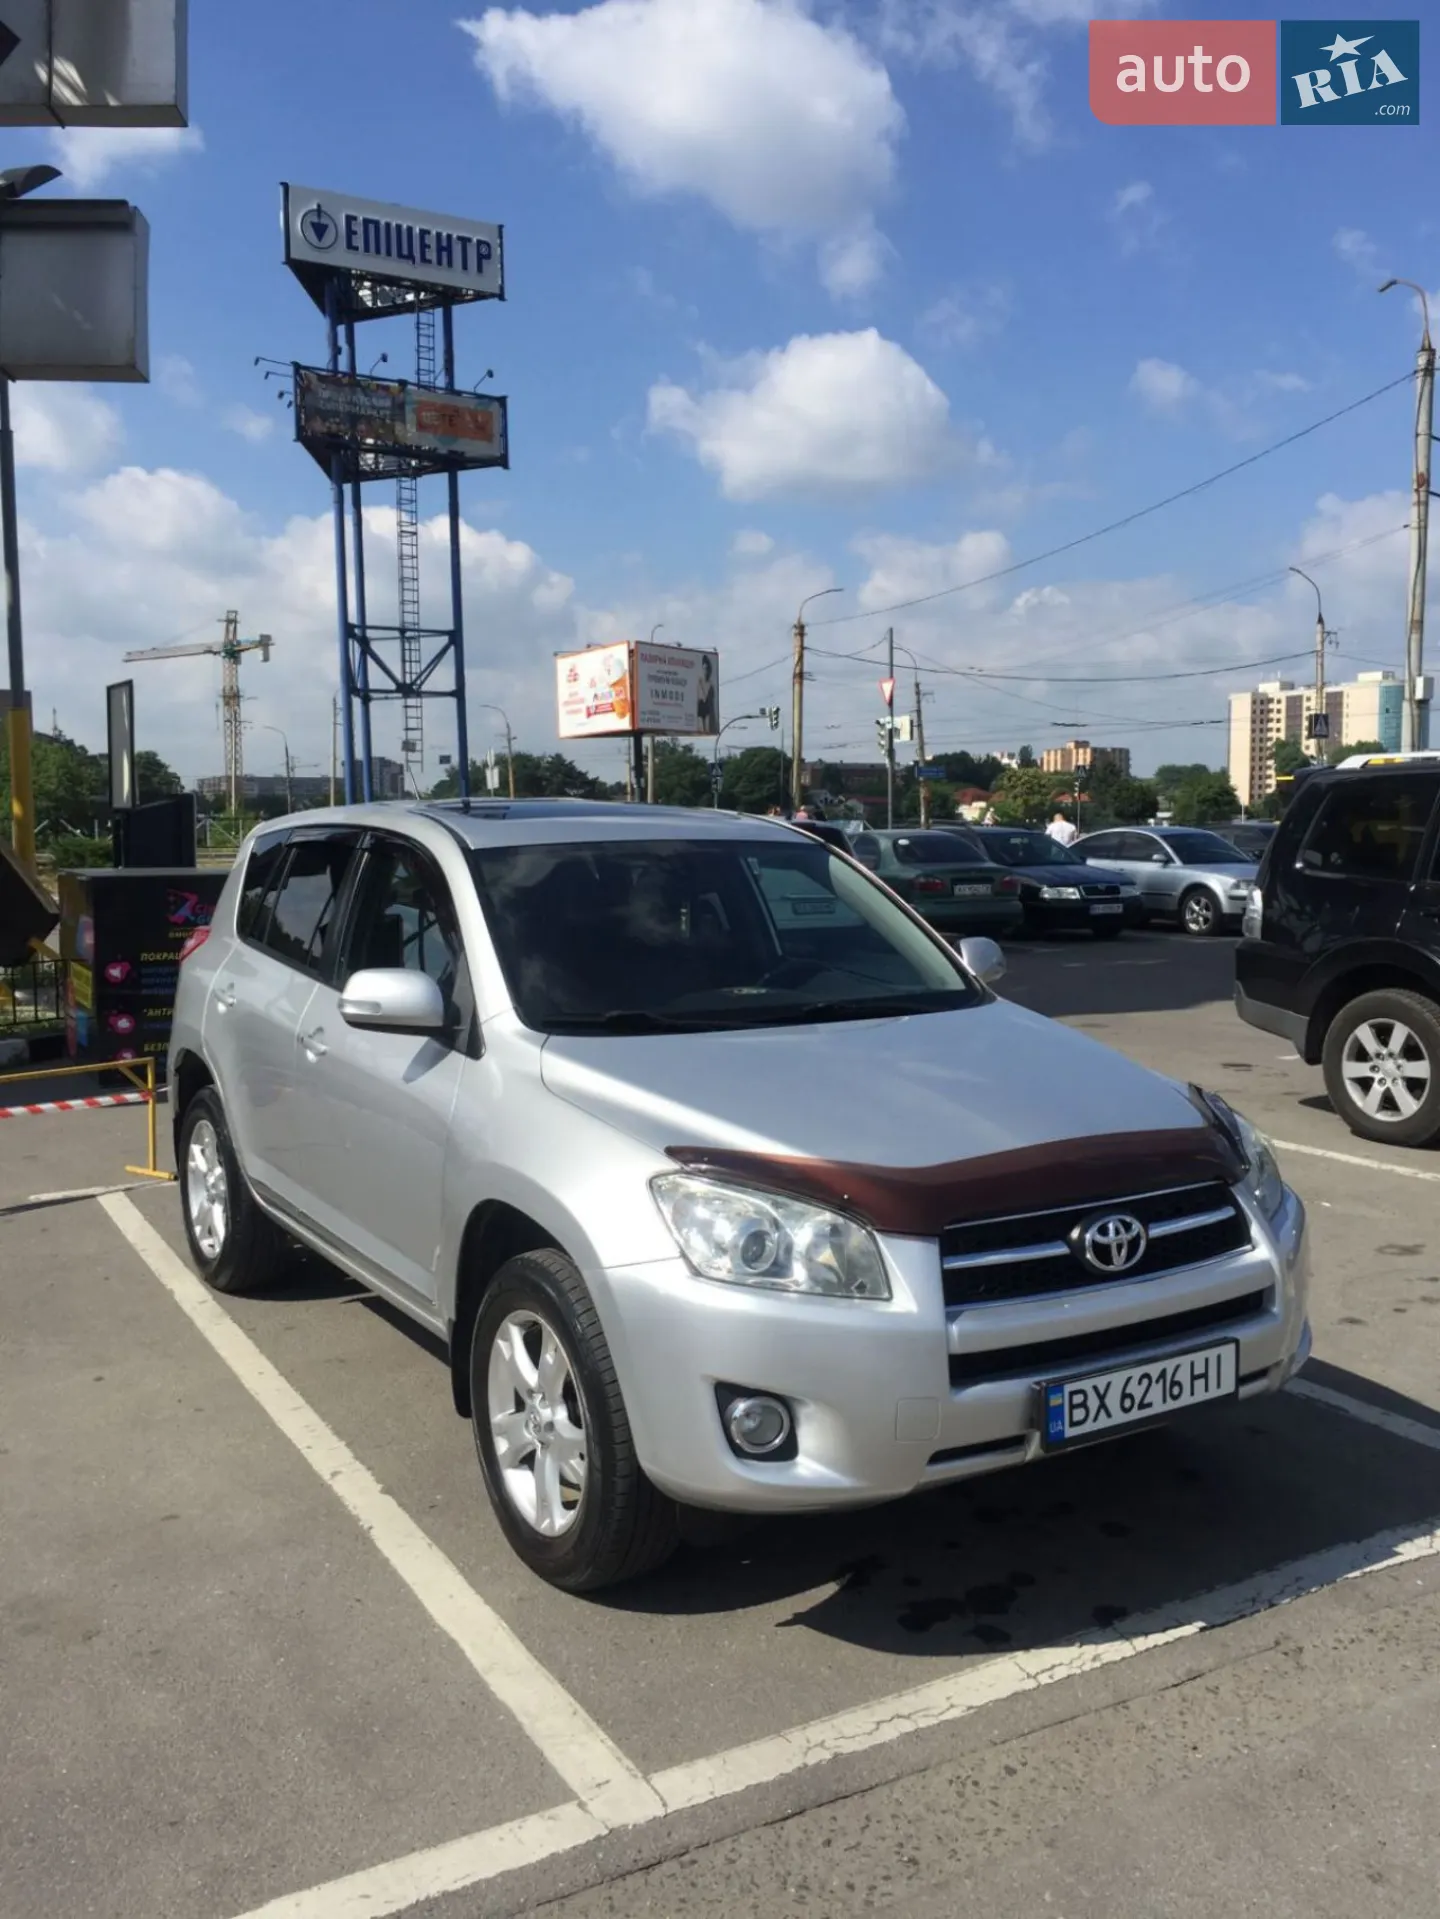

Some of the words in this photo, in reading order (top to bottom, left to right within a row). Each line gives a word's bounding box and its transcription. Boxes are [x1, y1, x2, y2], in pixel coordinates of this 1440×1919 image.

[344, 214, 492, 273] ЕПІЦЕНТР
[1067, 1380, 1113, 1429] BX
[1119, 1363, 1184, 1415] 6216
[1189, 1352, 1222, 1397] HI
[1049, 1421, 1064, 1434] UA
